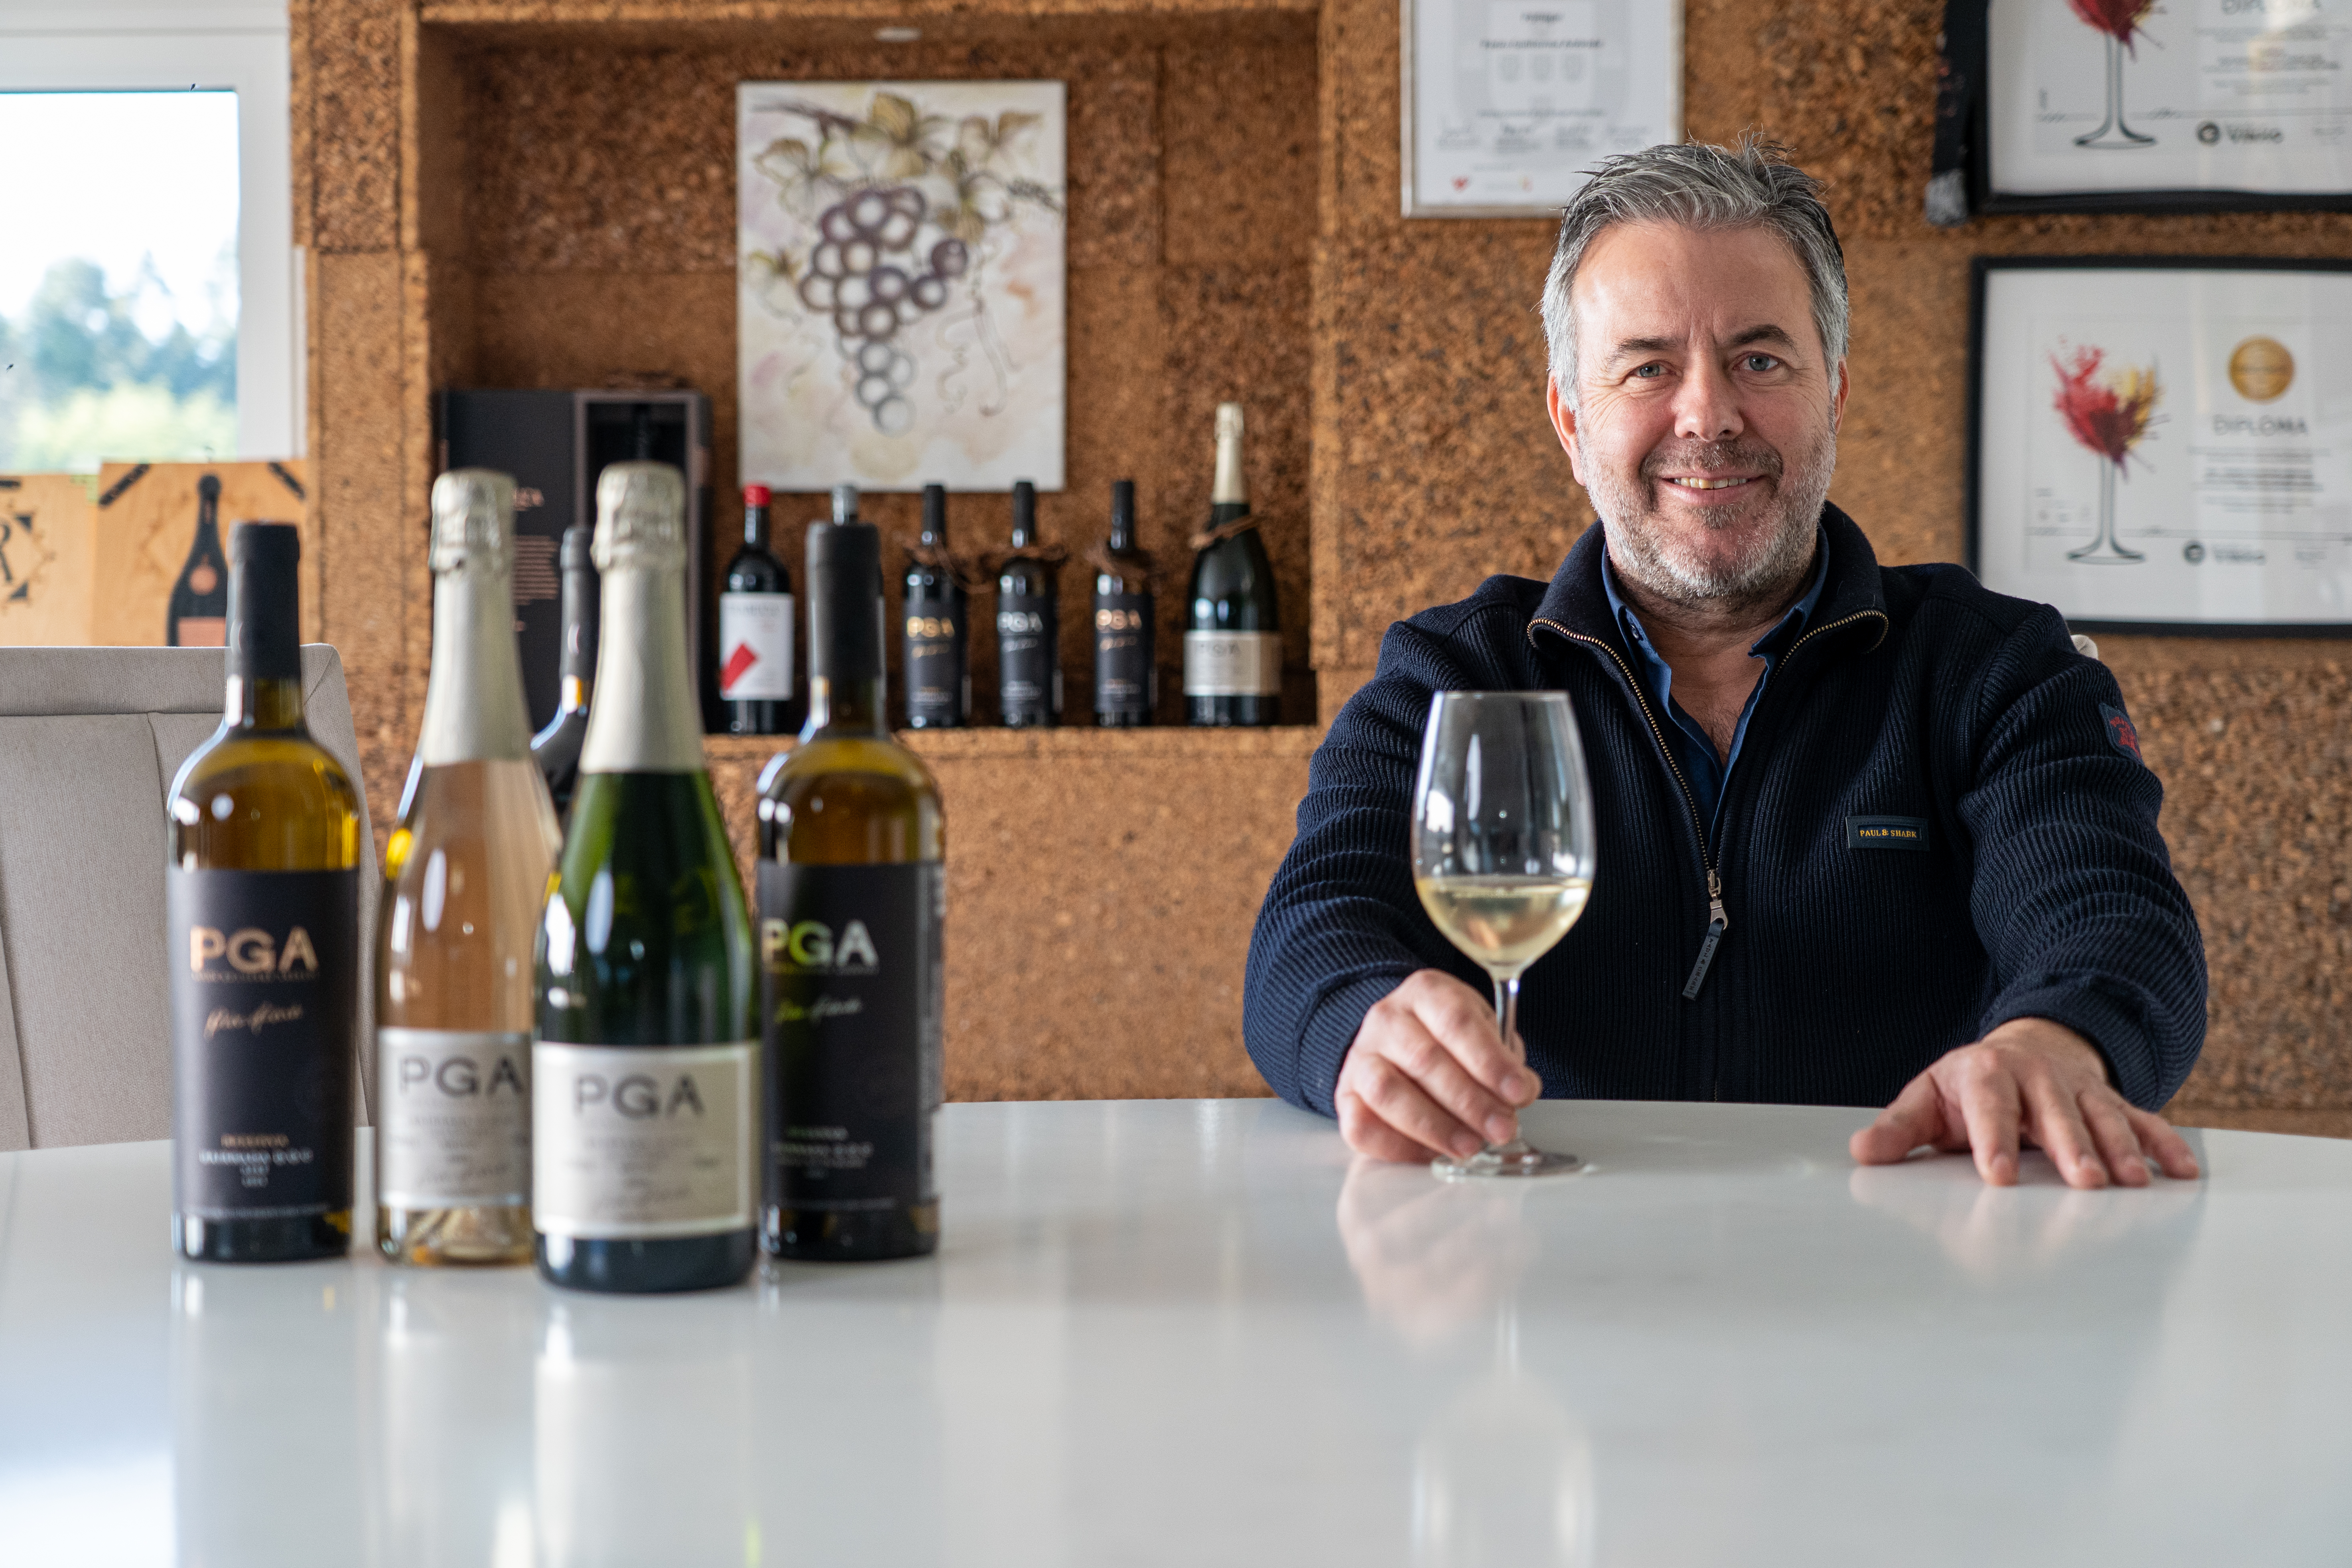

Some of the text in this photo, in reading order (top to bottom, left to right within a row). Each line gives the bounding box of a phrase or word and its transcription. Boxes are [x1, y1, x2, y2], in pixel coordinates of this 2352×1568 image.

[190, 926, 319, 973] PGA
[762, 917, 877, 967] PGA
[1703, 938, 1714, 958] PAUL
[401, 1055, 522, 1097] PGA
[574, 1073, 704, 1120] PGA
